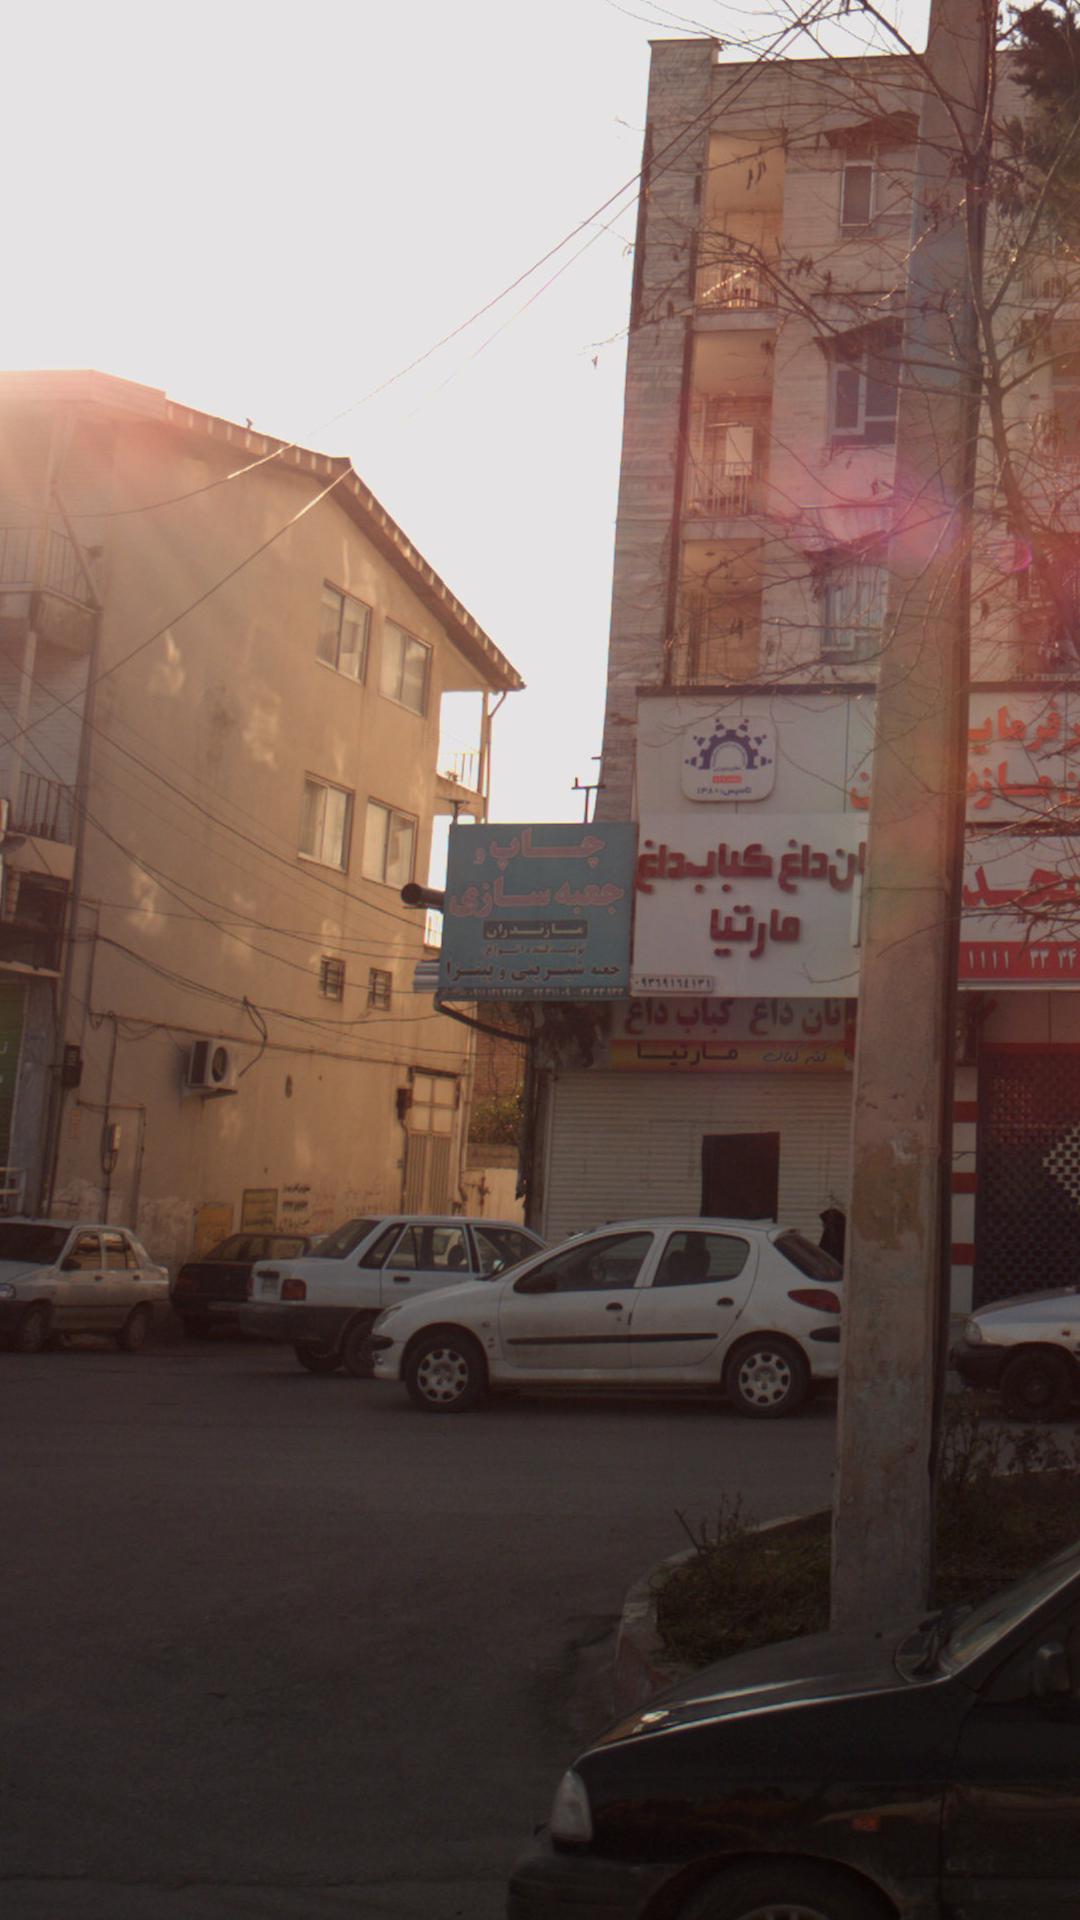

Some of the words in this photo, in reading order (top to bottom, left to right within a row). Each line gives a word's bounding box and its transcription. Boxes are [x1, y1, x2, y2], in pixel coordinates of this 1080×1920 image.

[473, 848, 486, 866] و
[490, 826, 605, 870] چاپ
[634, 839, 686, 894] داغ
[686, 842, 774, 893] کباب
[778, 839, 829, 893] داغ
[449, 874, 550, 918] سازی
[554, 879, 626, 915] جعبه
[486, 922, 584, 939] مازندران
[709, 904, 801, 960] مارتیا
[676, 998, 735, 1035] کباب
[801, 998, 843, 1036] نان
[636, 1040, 739, 1066] مارتیا
